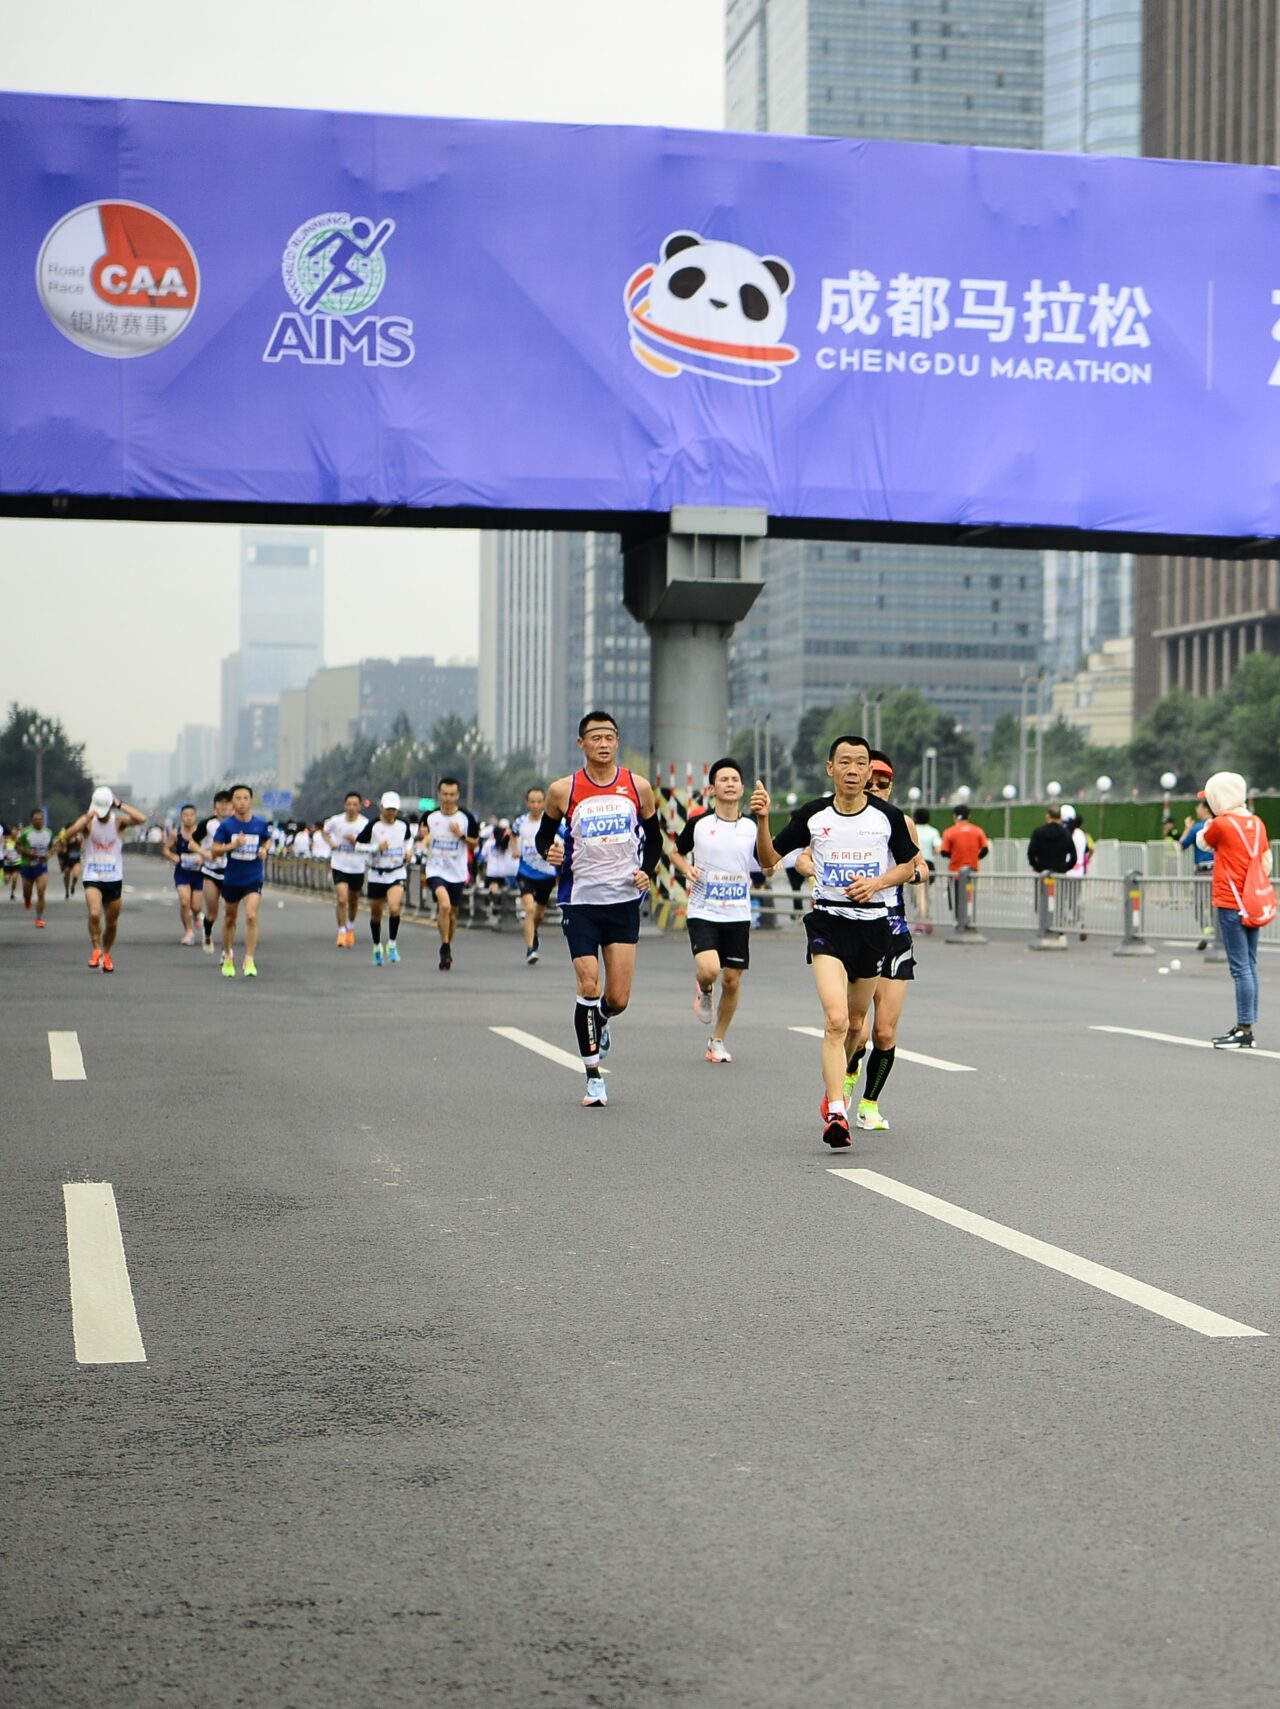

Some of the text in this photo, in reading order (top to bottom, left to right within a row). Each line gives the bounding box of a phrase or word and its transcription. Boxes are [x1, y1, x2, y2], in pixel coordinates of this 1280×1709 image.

[100, 263, 189, 298] CAA
[70, 309, 168, 337] 银牌赛事
[815, 268, 1152, 349] 成都马拉松
[262, 312, 415, 367] AIMS
[815, 346, 1152, 384] CHENGDU MARATHON
[586, 817, 627, 833] A0713
[709, 886, 745, 898] A2410
